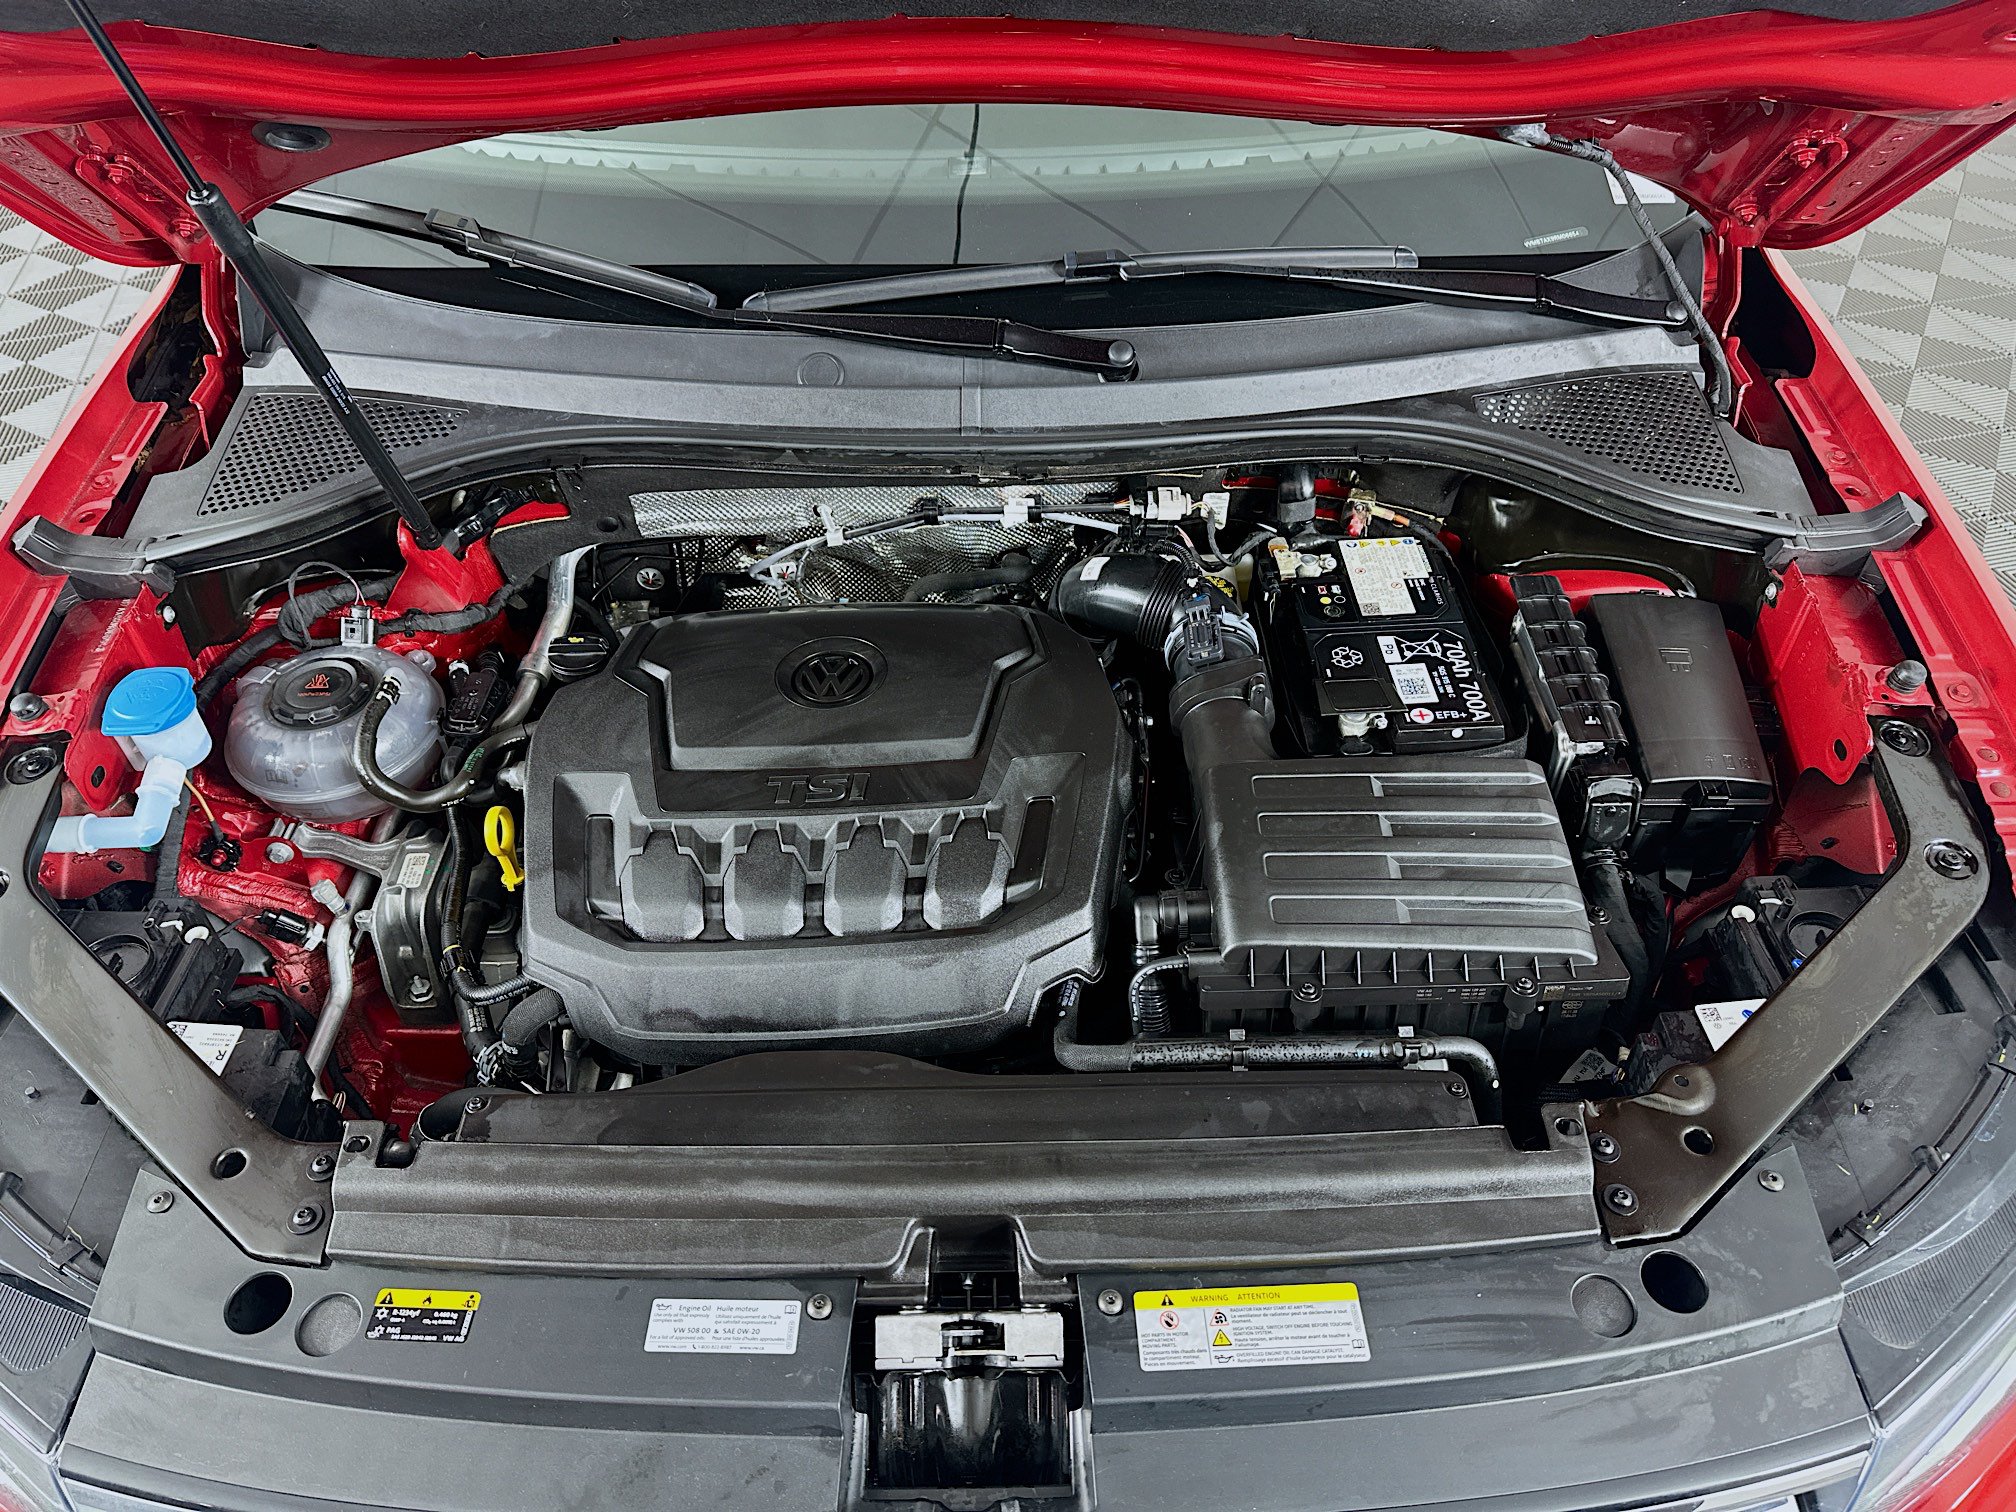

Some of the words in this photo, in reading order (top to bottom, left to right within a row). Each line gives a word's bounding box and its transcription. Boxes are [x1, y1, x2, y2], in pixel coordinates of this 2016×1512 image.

[1382, 644, 1394, 655] Pb
[1443, 640, 1472, 678] 70Ah
[1459, 681, 1492, 722] 700A
[1435, 710, 1468, 720] EFB+
[766, 772, 871, 804] TSI
[216, 1050, 226, 1060] R
[1238, 1292, 1280, 1300] ATTENTION
